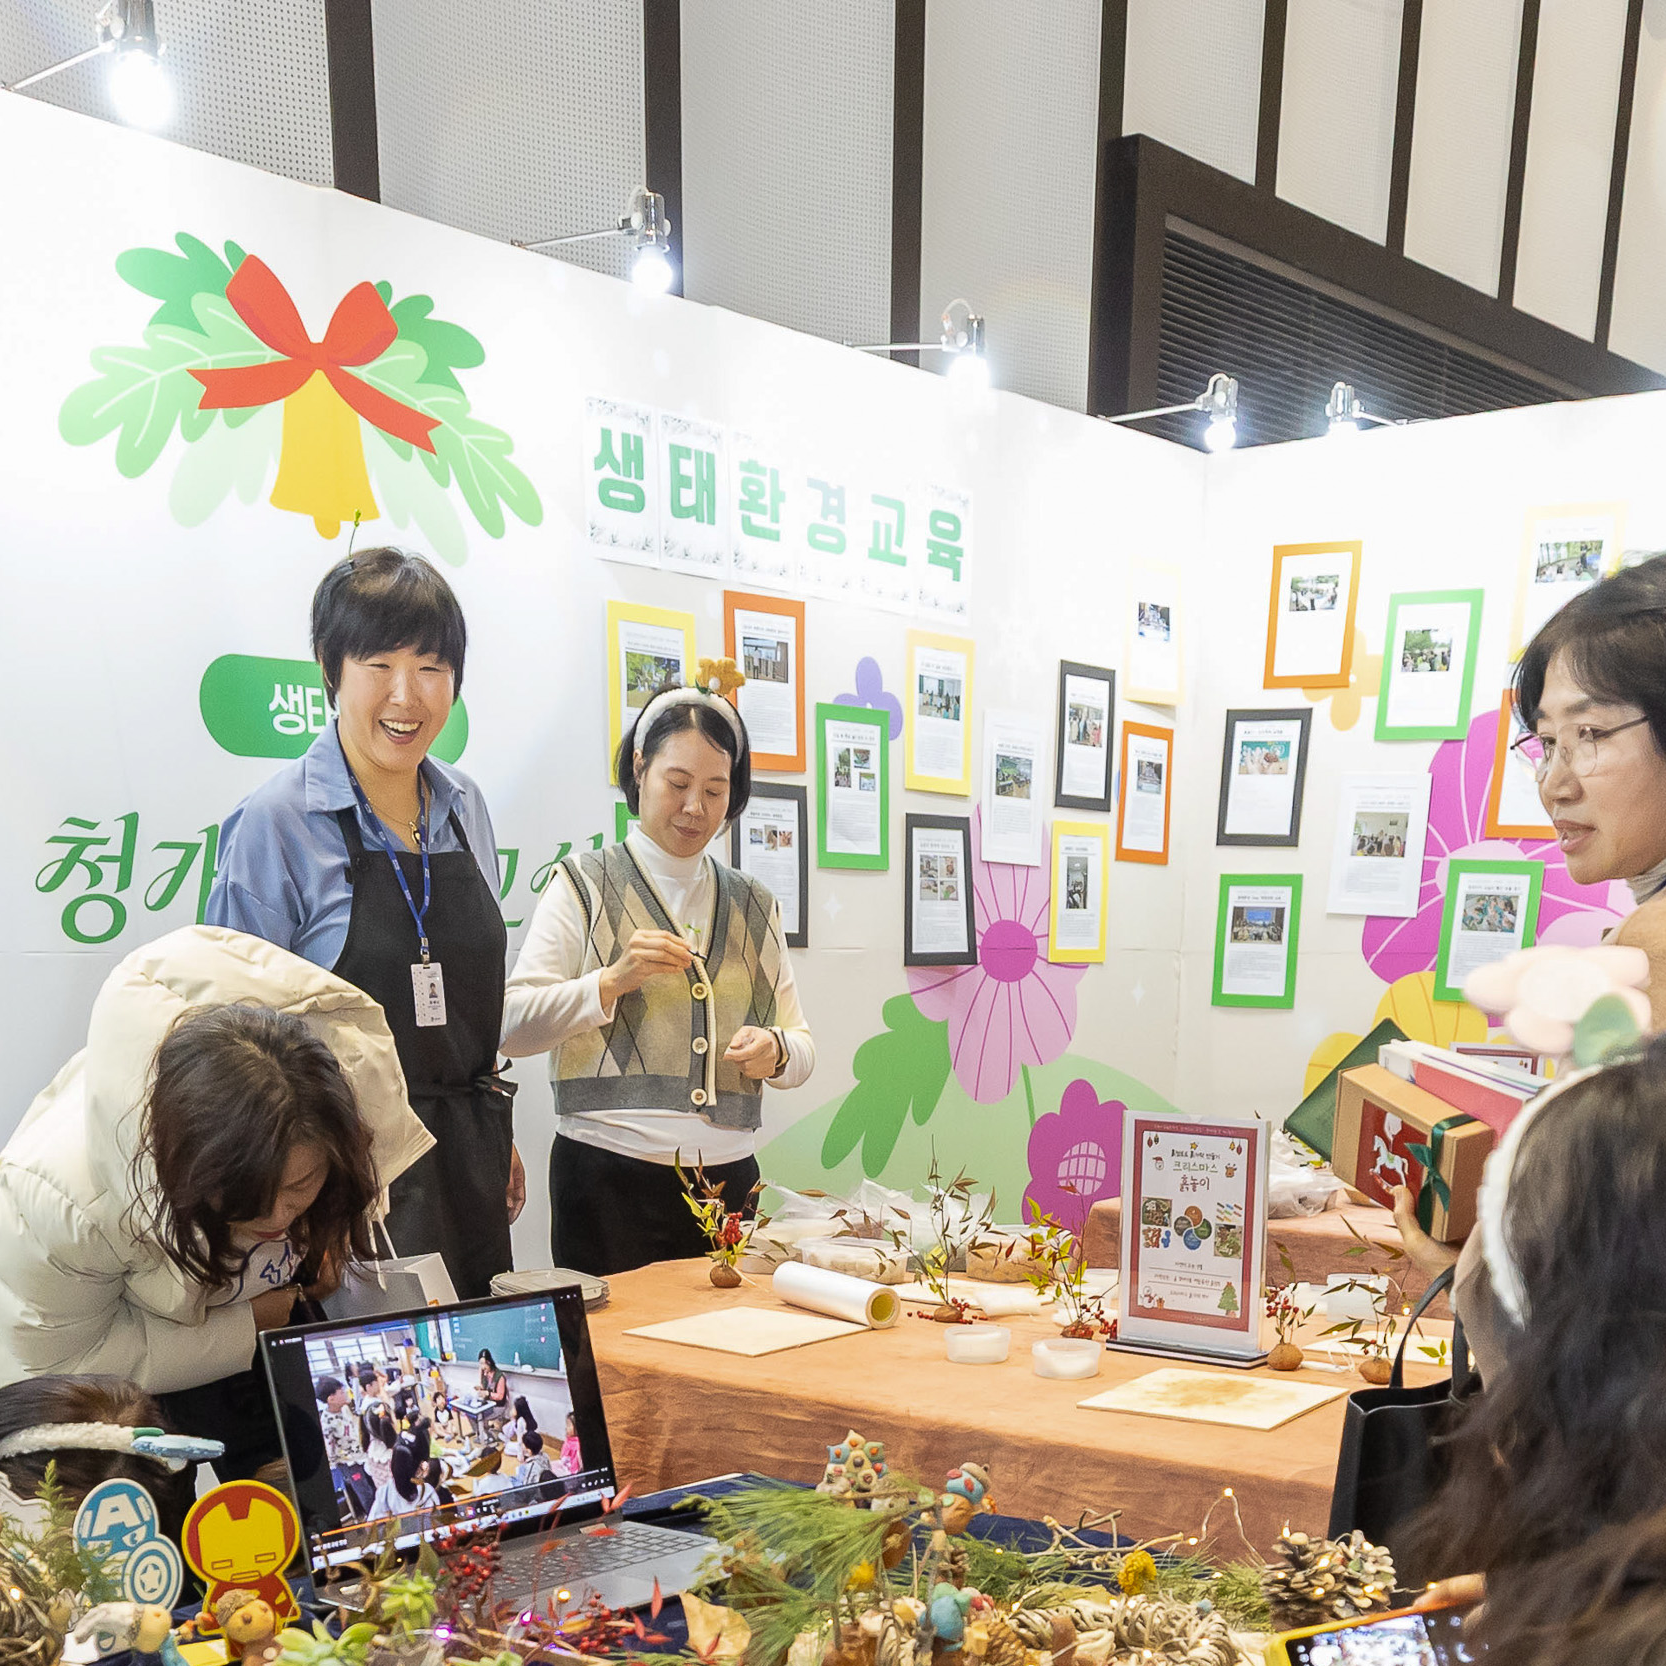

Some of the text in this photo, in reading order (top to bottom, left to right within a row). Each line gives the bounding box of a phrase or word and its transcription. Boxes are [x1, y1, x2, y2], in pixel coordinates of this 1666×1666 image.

[593, 426, 965, 583] 생태환경교육
[1173, 1160, 1219, 1173] 크리스마스
[1179, 1174, 1210, 1192] 흙놀이
